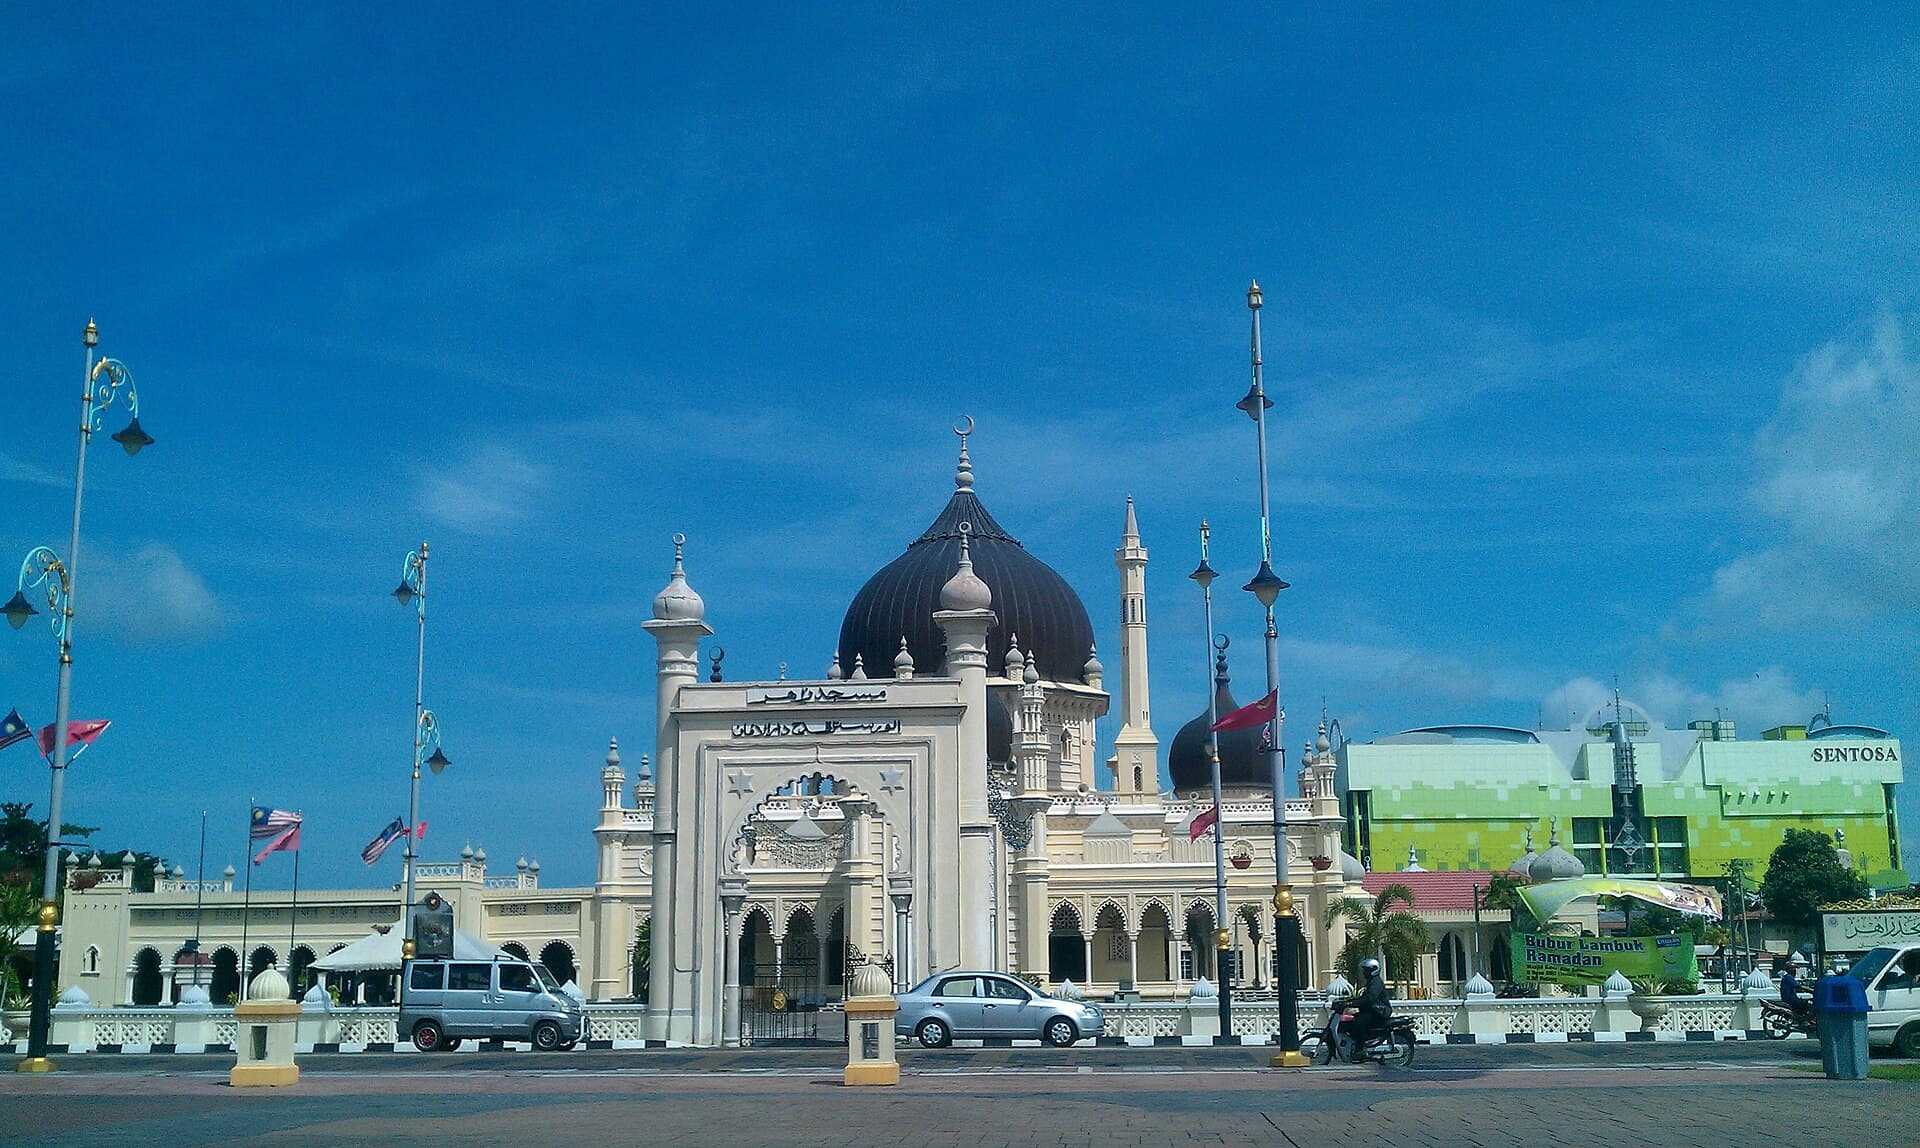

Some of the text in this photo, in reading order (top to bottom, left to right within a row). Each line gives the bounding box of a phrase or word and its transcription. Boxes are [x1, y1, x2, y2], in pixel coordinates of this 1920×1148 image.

[815, 686, 887, 703] مسجد
[1813, 746, 1898, 762] SENTOSA
[1525, 934, 1574, 950] Bubur
[1578, 939, 1645, 952] Lambuk
[1526, 950, 1603, 966] Ramadan
